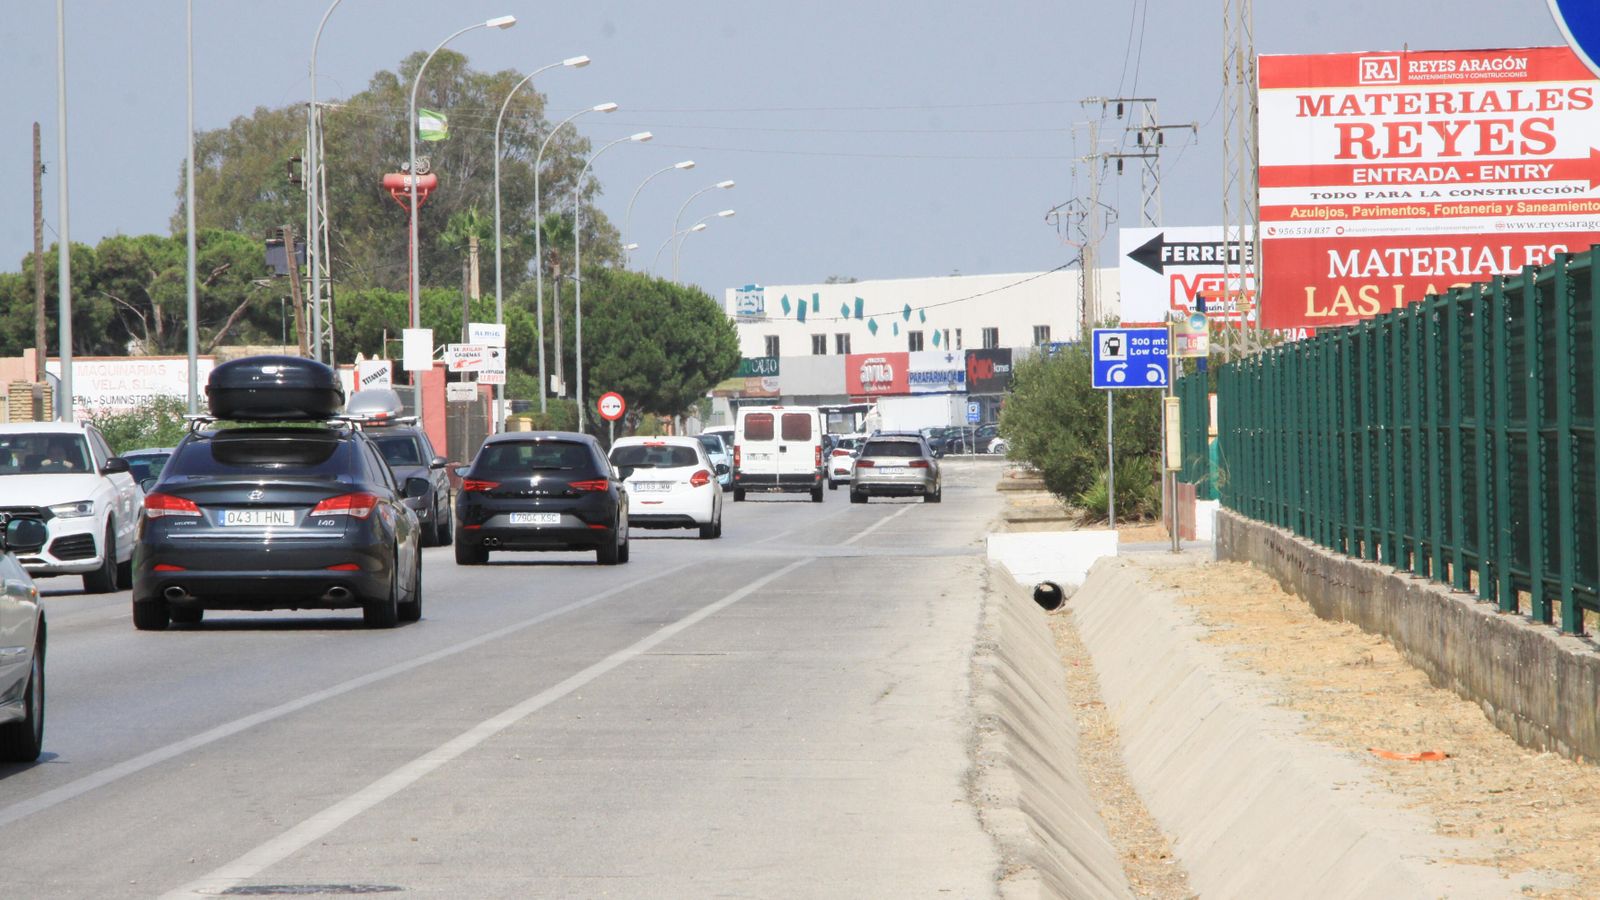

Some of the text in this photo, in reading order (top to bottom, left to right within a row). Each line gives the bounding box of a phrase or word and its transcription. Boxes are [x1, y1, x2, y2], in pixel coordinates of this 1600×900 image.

[1364, 61, 1395, 79] RA
[1408, 56, 1528, 73] REYES ARAGÓN
[1408, 73, 1464, 81] MANTENIMIENTOS
[1470, 71, 1528, 79] CONSTRUCCIONES
[1296, 87, 1594, 117] MATERIALES
[1334, 117, 1557, 160] REYES
[1352, 167, 1460, 183] ENTRADA
[1479, 164, 1554, 180] ENTRY
[1310, 185, 1585, 200] TODO PARA LA CONSTRUCCIÓN
[1290, 206, 1349, 220] Azulejos,
[1352, 204, 1431, 217] Pavimentos,
[1434, 202, 1503, 215] Fontanería
[1505, 204, 1514, 216] y
[1304, 284, 1381, 317] LAS
[1131, 338, 1150, 346] 300
[1130, 348, 1150, 356] Low
[78, 364, 167, 377] MAQUINARIAS
[227, 511, 290, 523] 0431 HNL
[516, 513, 537, 522] 7904
